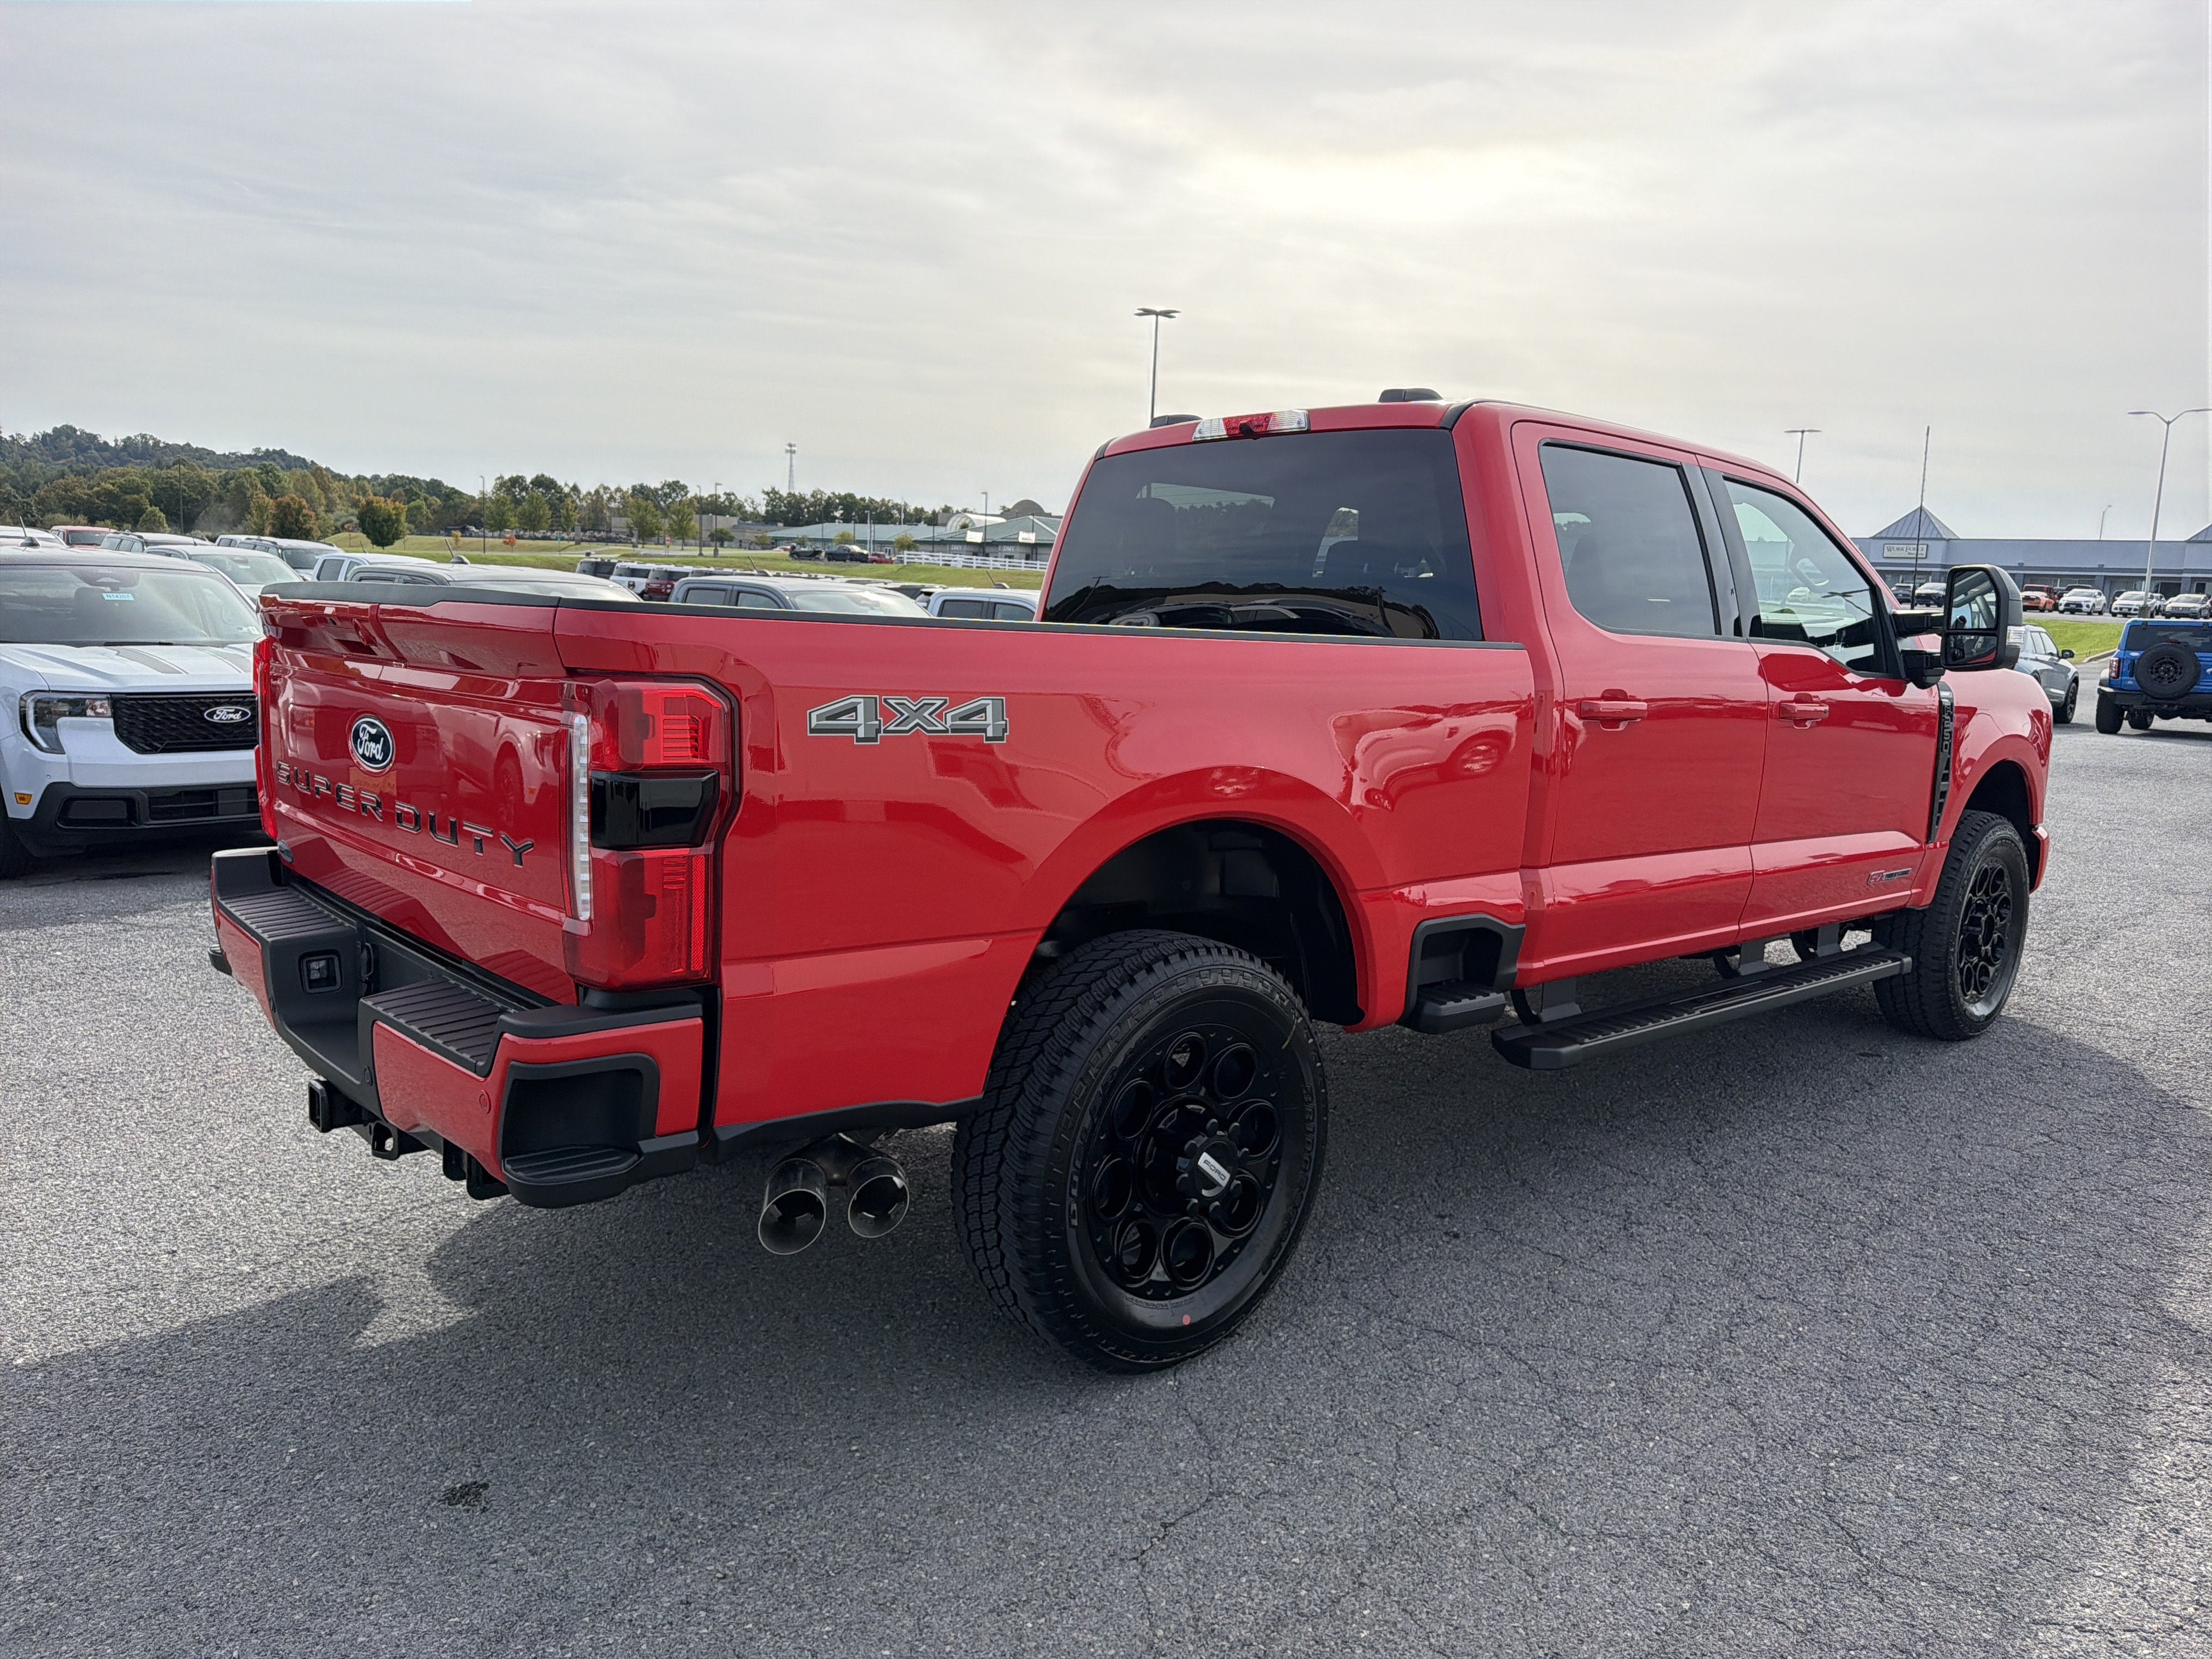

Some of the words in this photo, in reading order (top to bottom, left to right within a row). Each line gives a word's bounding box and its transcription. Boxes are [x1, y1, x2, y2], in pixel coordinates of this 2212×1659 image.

[213, 708, 242, 720] Ford
[808, 695, 1009, 744] 4X4
[358, 724, 384, 760] Ford
[276, 760, 383, 821] SUPER
[395, 800, 534, 868] DUTY
[1203, 1159, 1226, 1181] FORD
